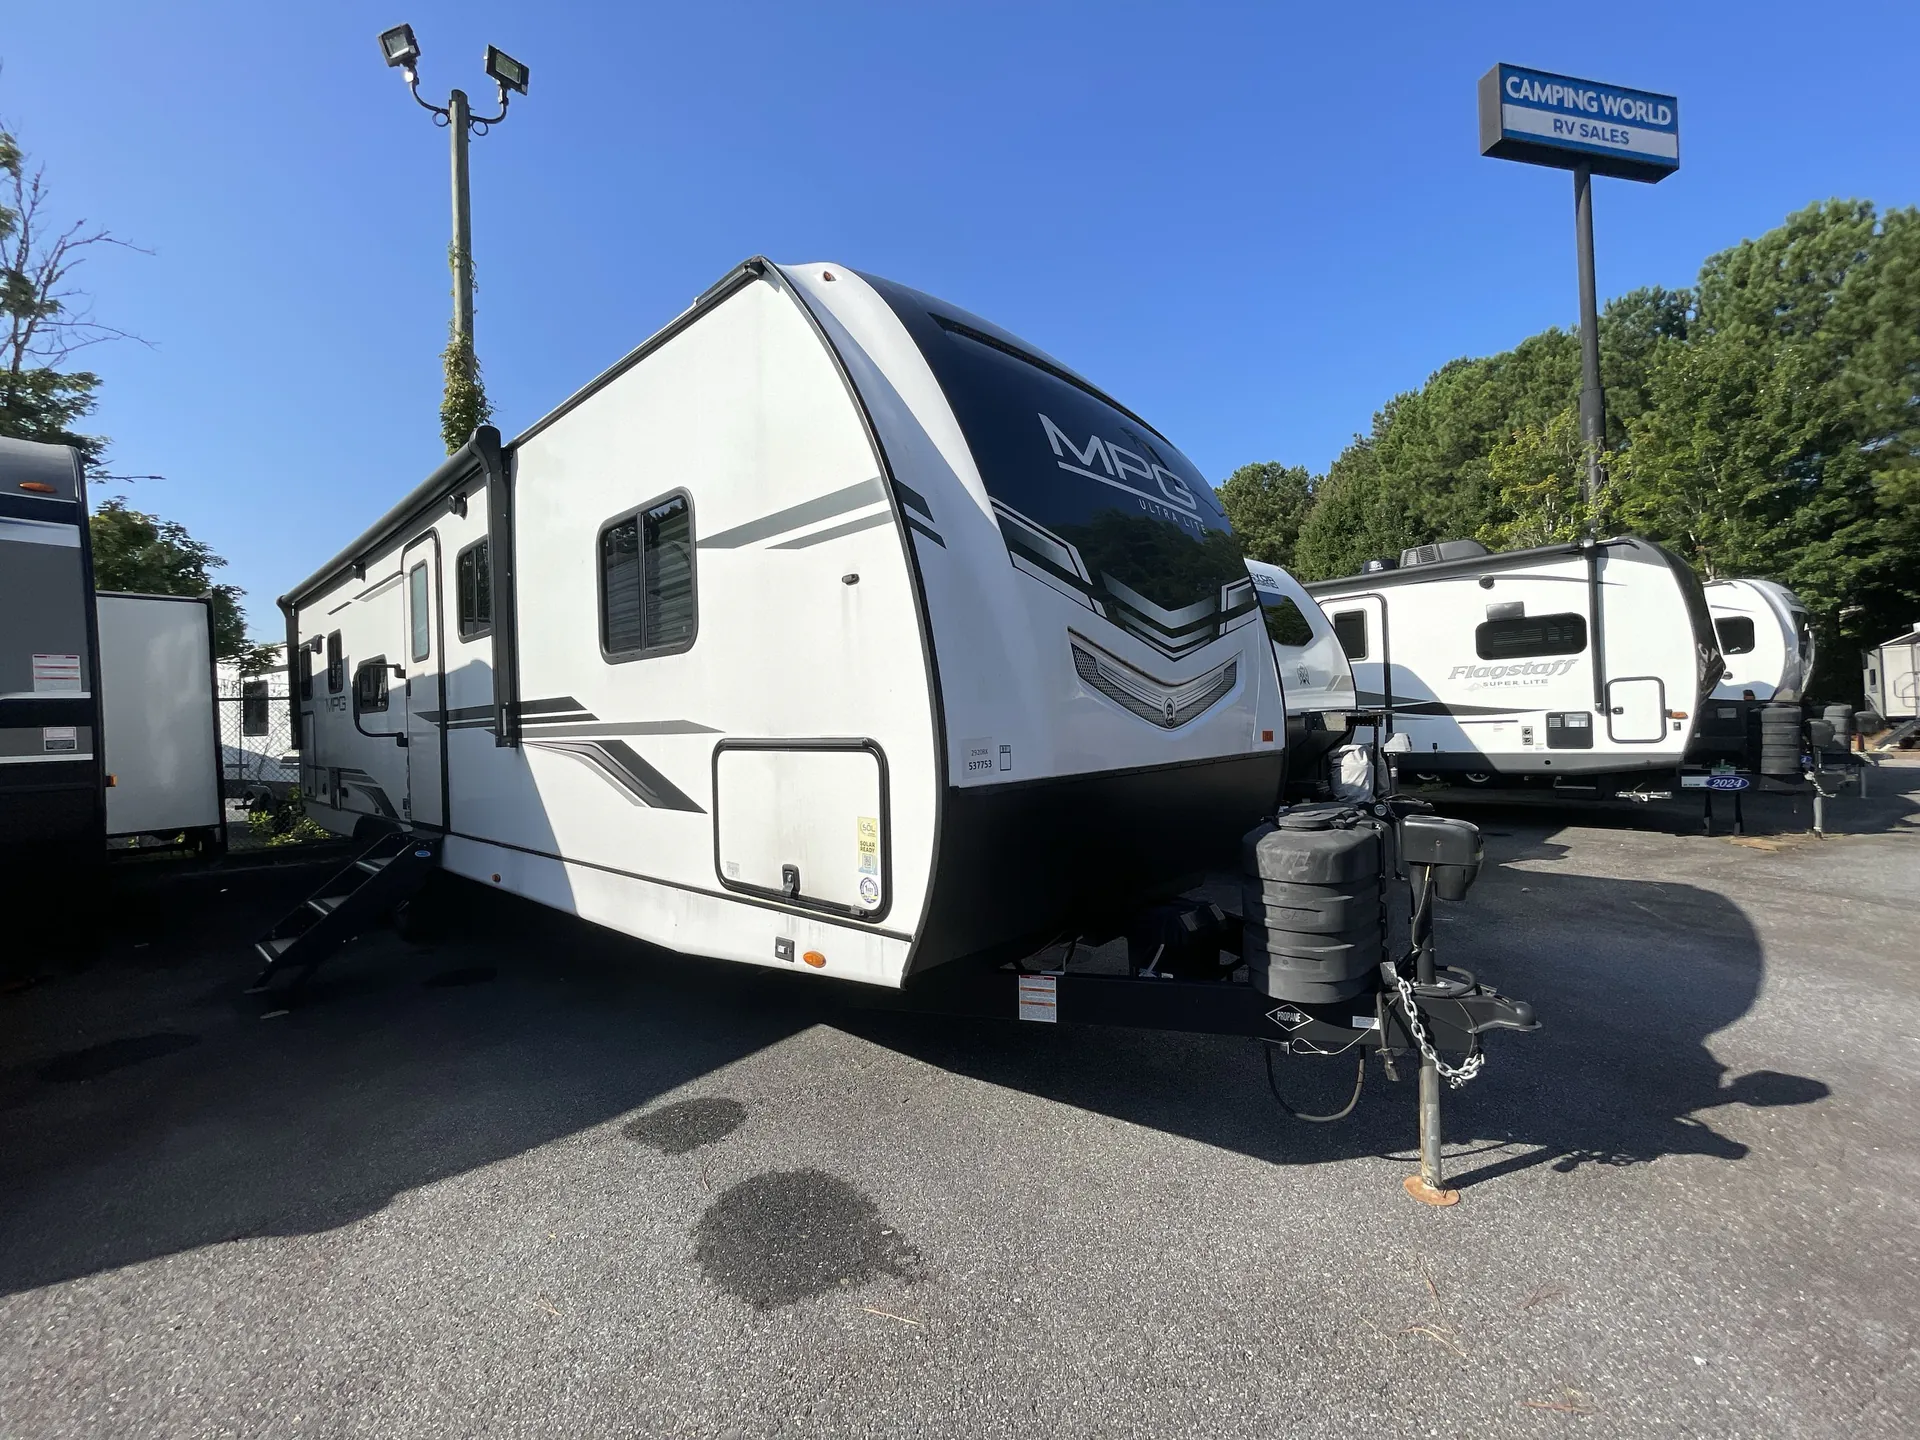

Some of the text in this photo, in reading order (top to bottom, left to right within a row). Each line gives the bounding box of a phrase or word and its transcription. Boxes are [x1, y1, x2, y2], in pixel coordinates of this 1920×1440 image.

[1505, 76, 1672, 126] CAMPING WORLD
[1553, 118, 1630, 145] RV SALES
[1037, 412, 1197, 511] MPG
[1138, 499, 1207, 535] ULTRA LITE
[1447, 658, 1580, 680] Flagstaff
[1482, 679, 1520, 688] SUPER
[968, 759, 993, 771] 537753
[1711, 778, 1743, 788] 2024
[859, 840, 876, 848] SOLAR
[859, 846, 876, 854] READY
[1276, 1010, 1301, 1023] PROPANE
